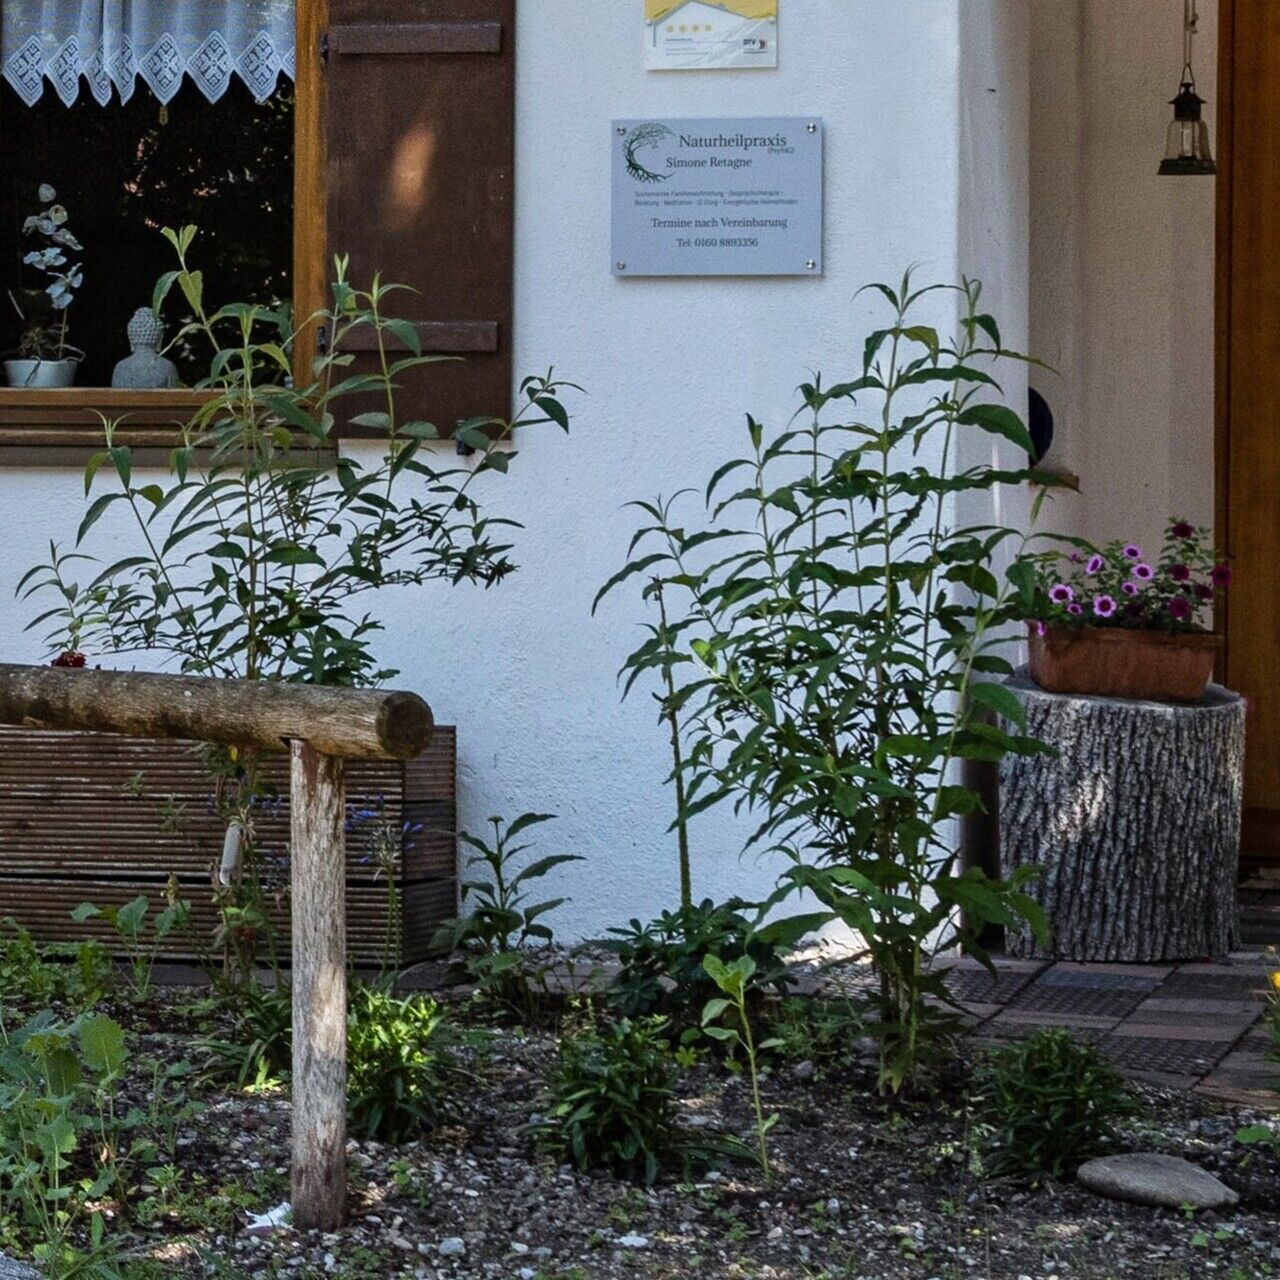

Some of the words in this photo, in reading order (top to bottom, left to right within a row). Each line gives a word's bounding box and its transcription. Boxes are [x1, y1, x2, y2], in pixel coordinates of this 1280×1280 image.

[679, 134, 787, 150] Naturheilpraxis
[666, 157, 707, 168] Simone
[710, 157, 752, 170] Retagne
[651, 218, 691, 228] Termine
[694, 218, 718, 228] nach
[721, 218, 788, 229] Vereinbarung
[694, 238, 718, 247] 0160
